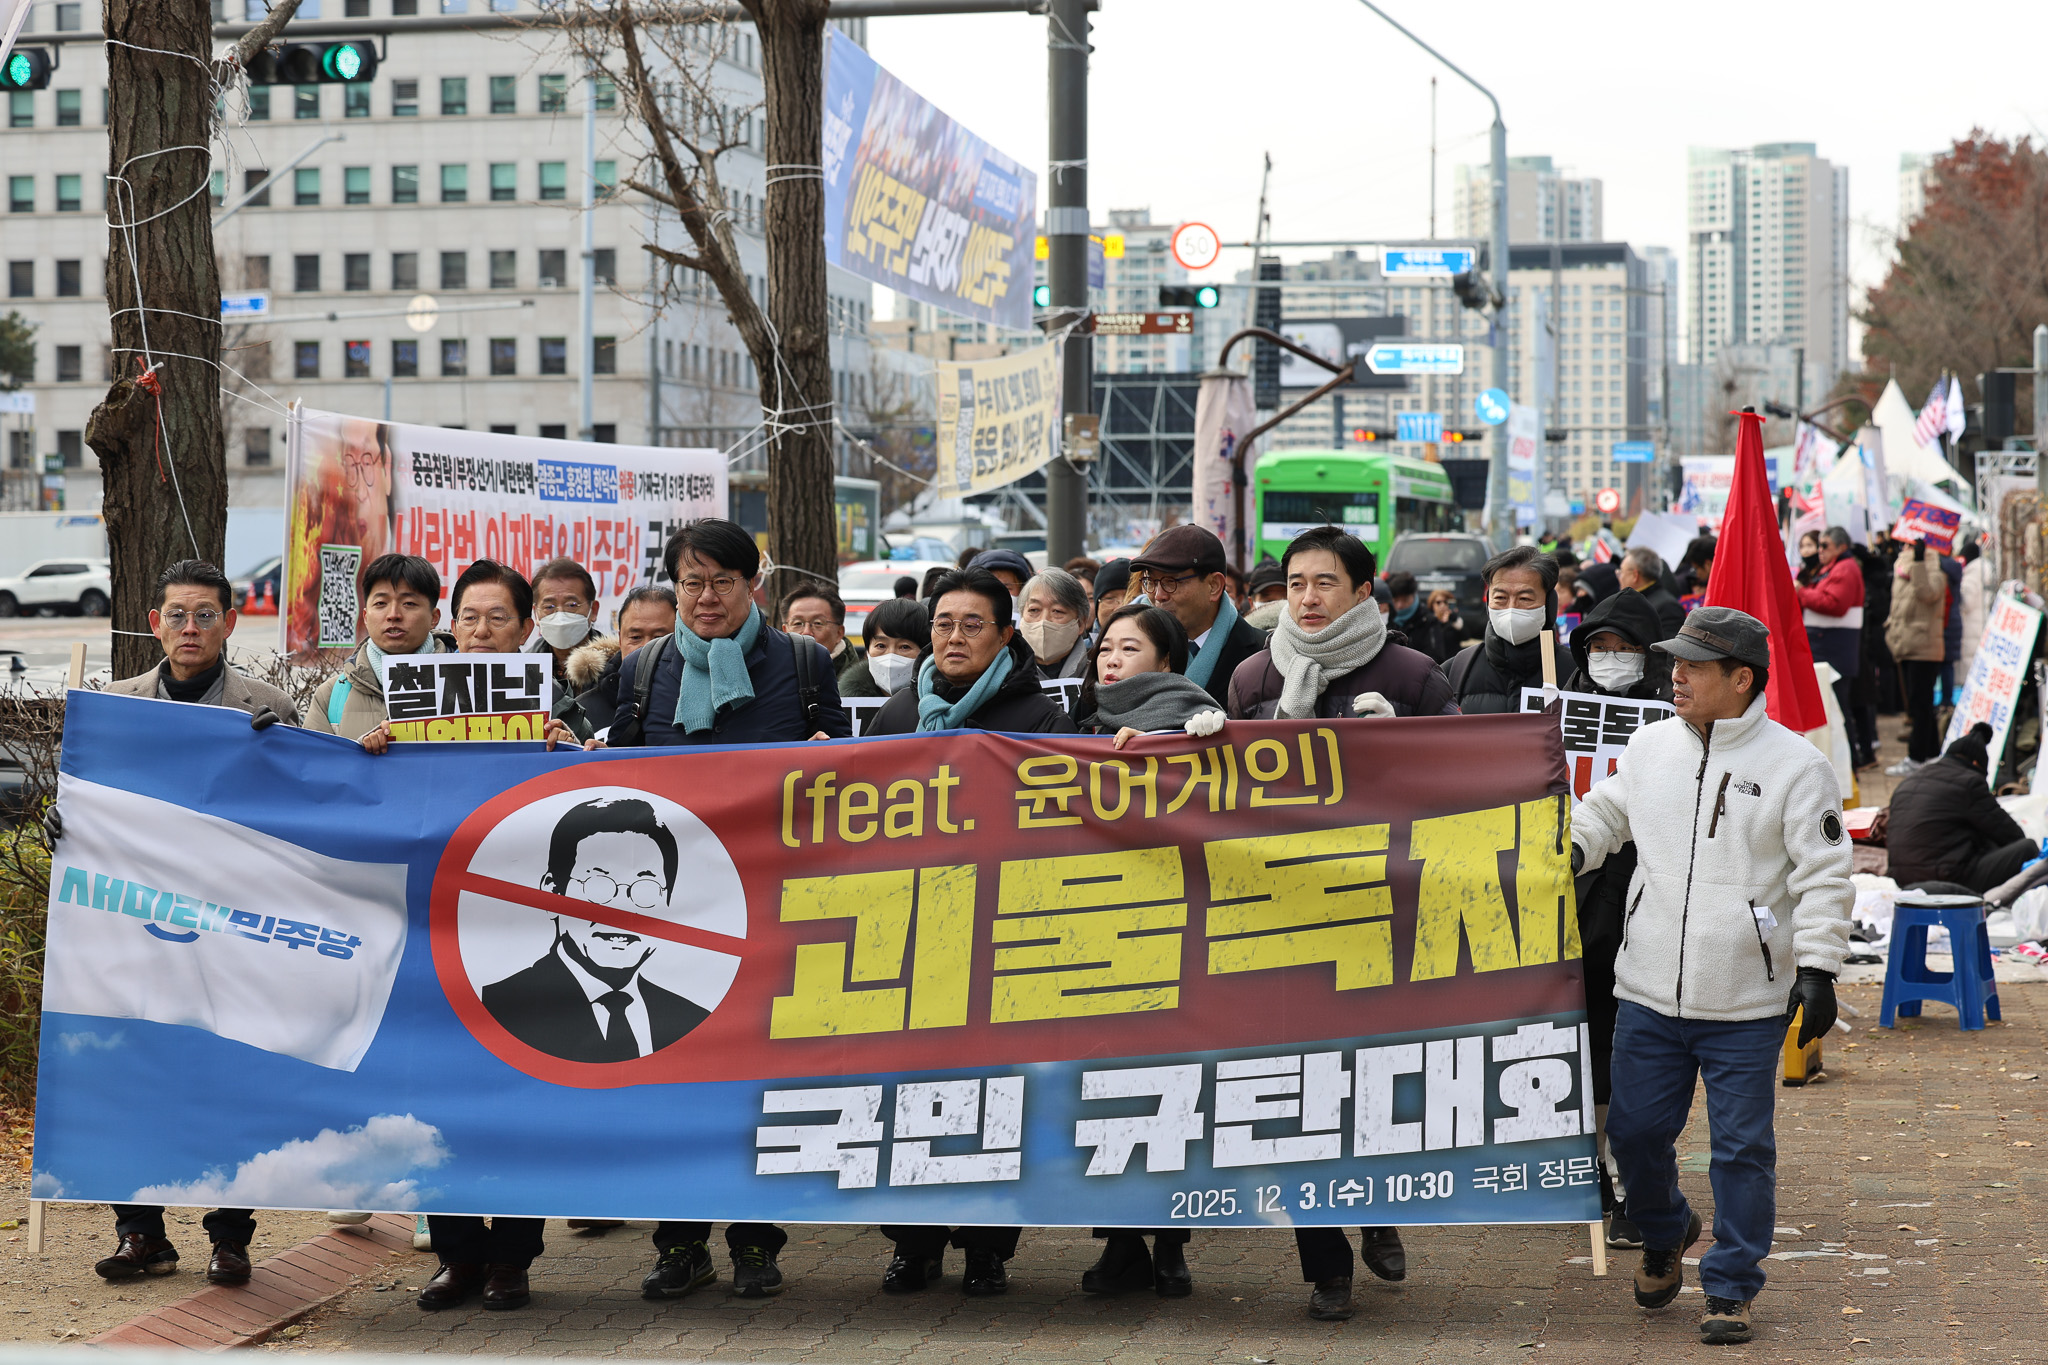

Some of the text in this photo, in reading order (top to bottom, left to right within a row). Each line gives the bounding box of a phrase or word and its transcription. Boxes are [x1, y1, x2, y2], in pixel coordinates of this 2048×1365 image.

[1185, 236, 1208, 256] 50
[669, 475, 684, 502] 51명
[1901, 499, 1961, 526] Free
[388, 663, 544, 719] 철지난
[782, 728, 1343, 847] (feat. 윤어게인)
[58, 866, 362, 960] 새미래민주당
[770, 794, 1582, 1039] 괴물독재
[756, 1022, 1596, 1189] 국민 규탄대회
[1171, 1189, 1242, 1219] 2025.
[1256, 1185, 1286, 1212] 12.
[1386, 1171, 1453, 1202] 10:30
[1472, 1163, 1527, 1194] 국회
